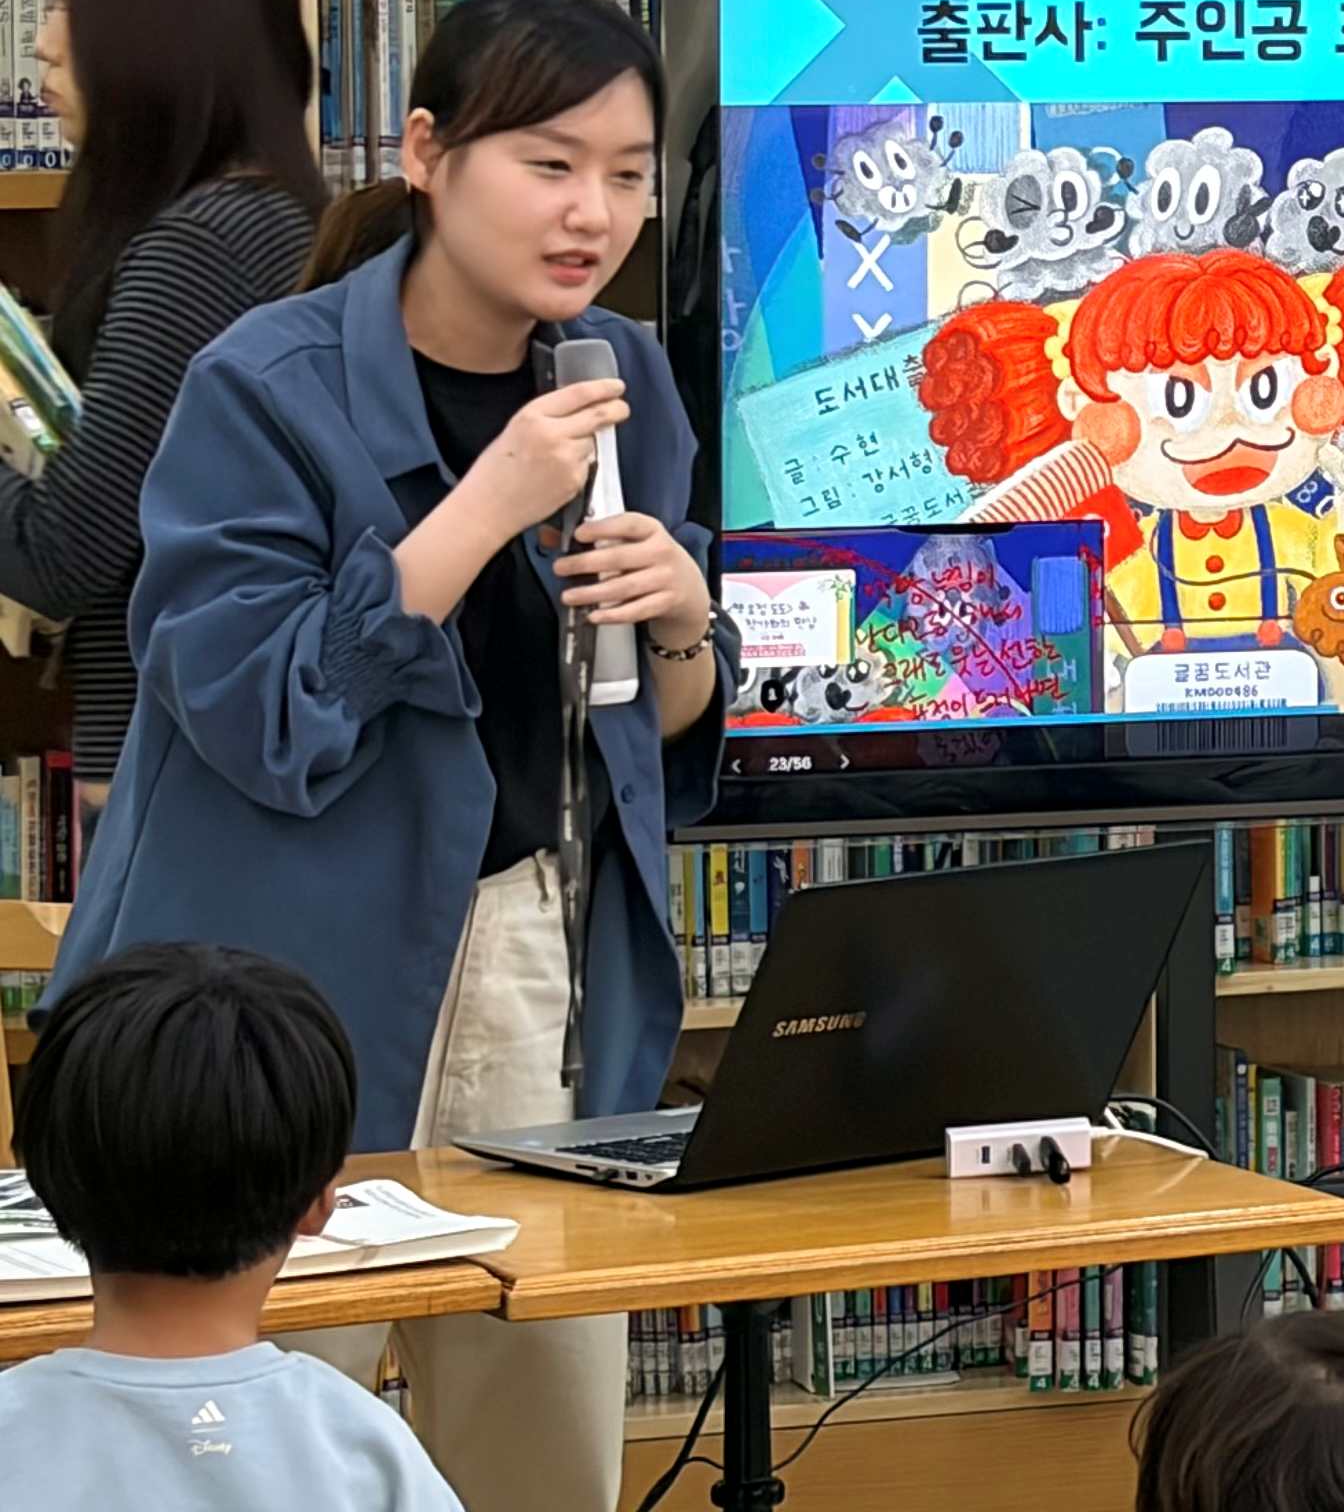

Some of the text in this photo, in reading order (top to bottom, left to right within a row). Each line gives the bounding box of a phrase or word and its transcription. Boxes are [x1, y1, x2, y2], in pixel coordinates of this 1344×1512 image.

[1174, 660, 1272, 683] 글꿈도서관
[768, 755, 812, 772] 23/56
[772, 1010, 867, 1038] SAMSUNG
